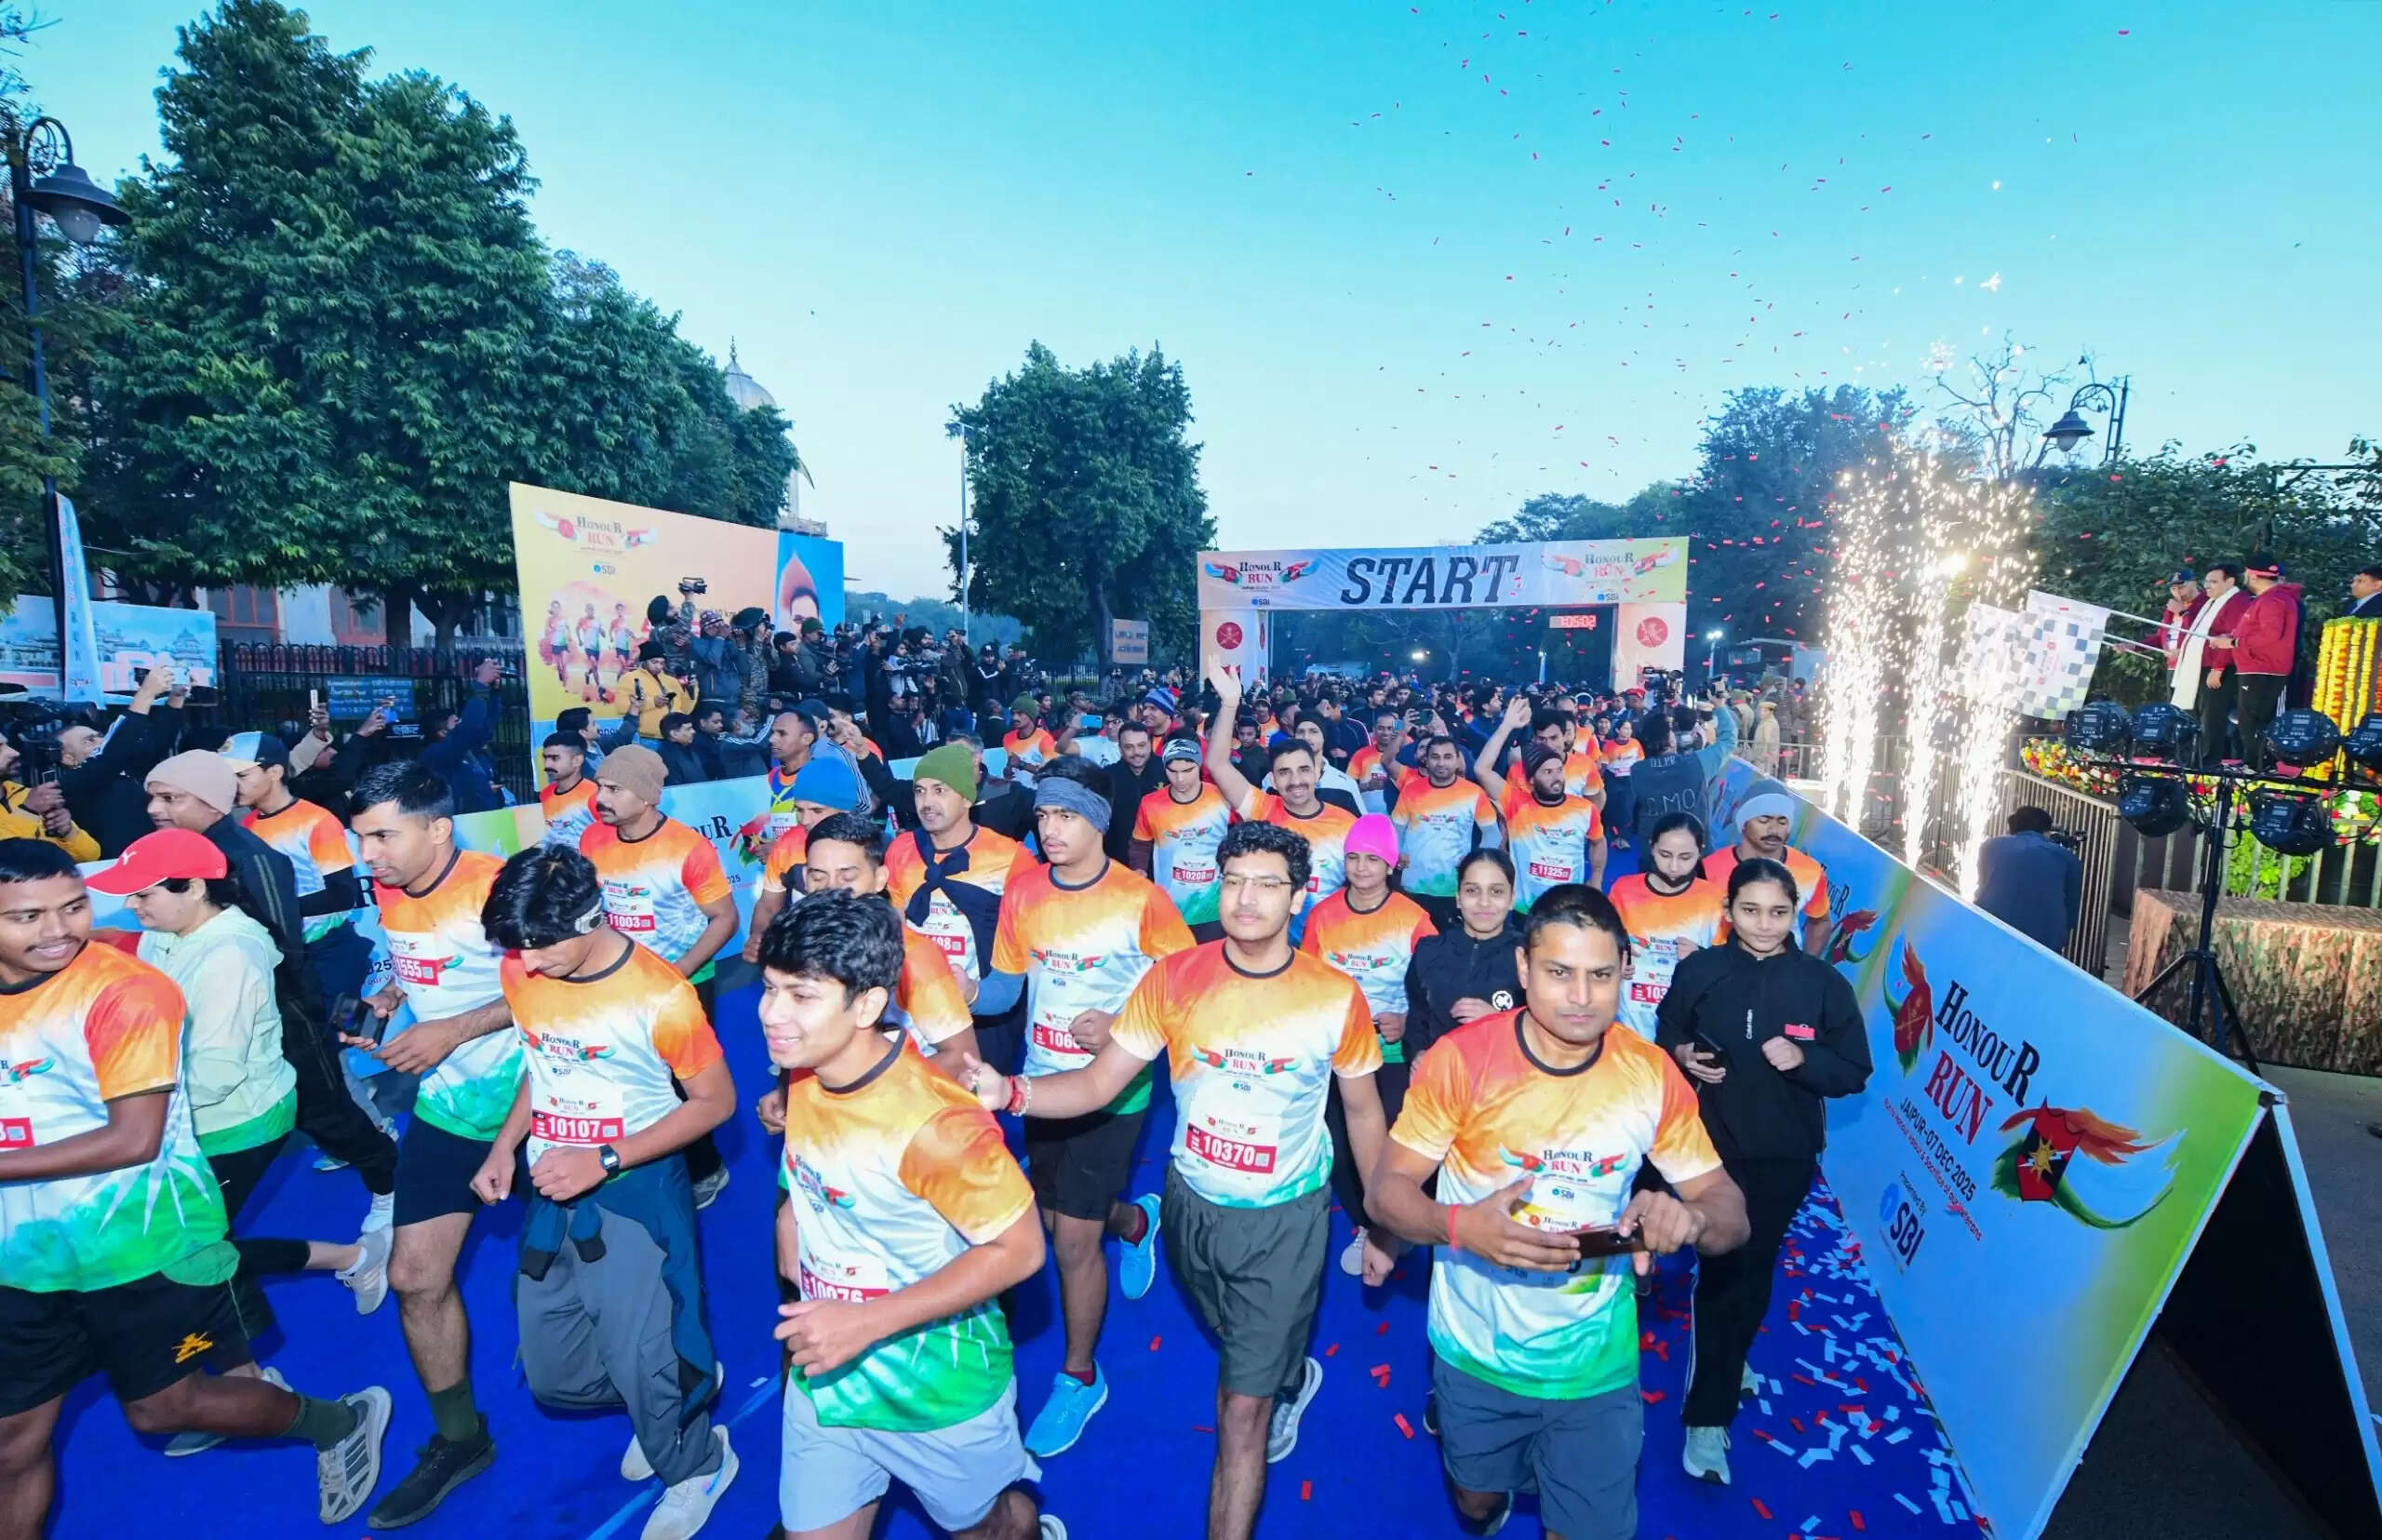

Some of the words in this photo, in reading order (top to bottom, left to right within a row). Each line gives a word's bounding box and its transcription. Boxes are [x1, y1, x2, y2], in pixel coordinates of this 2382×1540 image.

[576, 516, 622, 533] HONOUR
[587, 531, 615, 546] RUN
[1239, 561, 1281, 572] HONOUR
[1585, 553, 1636, 564] HONOUR
[1248, 573, 1273, 583] RUN
[1594, 565, 1624, 578] RUN
[1340, 555, 1520, 605] START
[609, 913, 641, 929] 11003
[1049, 1030, 1080, 1049] 106
[1934, 979, 2041, 1108] HONOUR
[1224, 1049, 1266, 1061] HONOUR
[1232, 1059, 1257, 1071] RUN
[1923, 1049, 1994, 1146] RUN
[548, 1116, 601, 1138] 10107
[1203, 1134, 1256, 1166] 10370
[1543, 1149, 1592, 1162] HONOUR
[1551, 1160, 1581, 1174] RUN
[1934, 1142, 1954, 1172] DEC
[1950, 1164, 1976, 1202] 2025
[1890, 1201, 1925, 1266] SBI
